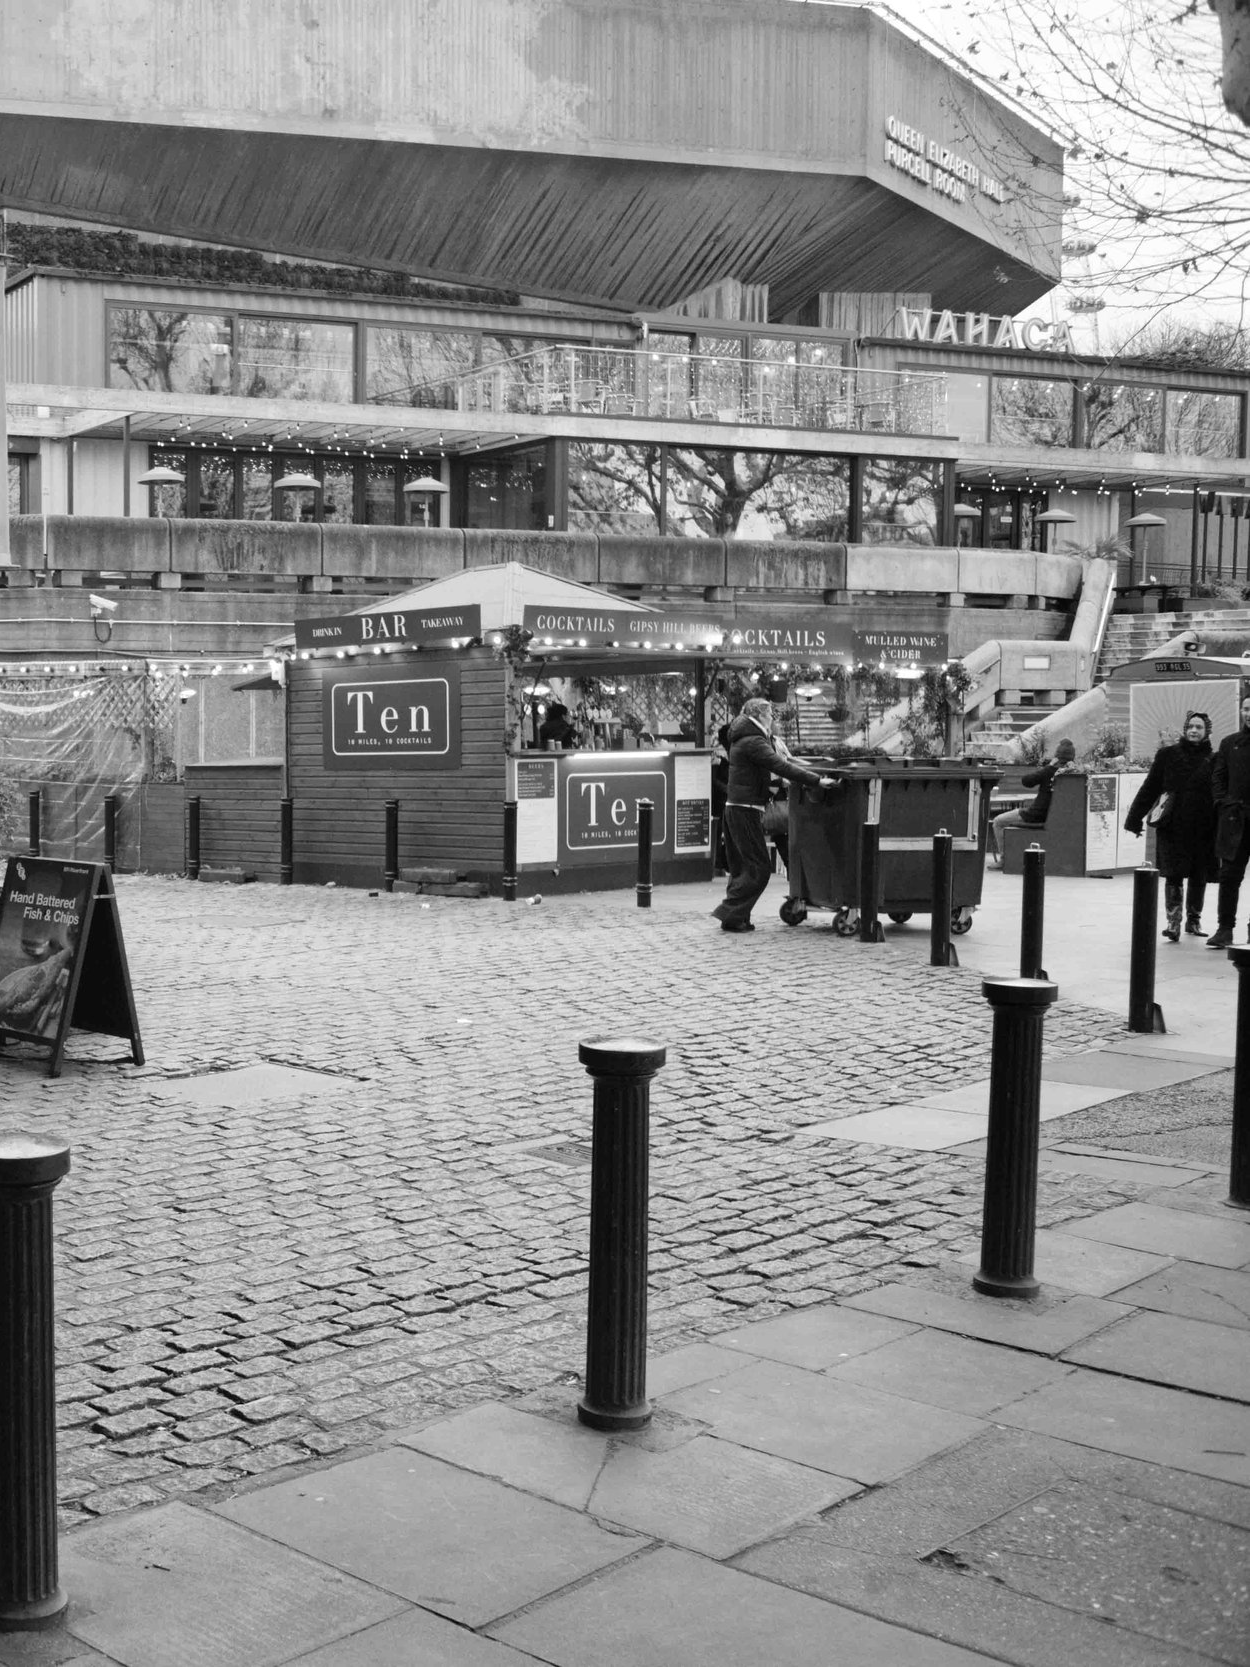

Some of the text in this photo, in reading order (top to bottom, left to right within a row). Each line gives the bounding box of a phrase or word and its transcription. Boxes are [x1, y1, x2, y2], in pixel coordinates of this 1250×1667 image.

[884, 115, 1004, 203] QUEEN ELIZABETH HALL
[884, 140, 966, 203] PURCELL ROOM
[900, 306, 1076, 355] WAHACA
[361, 614, 407, 640] BAR
[421, 616, 464, 629] TAKEAWAY
[537, 614, 615, 633] COCKTAILS
[630, 620, 659, 633] GIPSY
[662, 622, 685, 634] HILL
[729, 628, 827, 648] OCKTAILS
[865, 635, 937, 647] MULLED WINE
[890, 649, 921, 659] CIDER
[347, 691, 432, 734] Ten
[10, 890, 76, 909] Hand Battered
[23, 906, 79, 926] Fish & Chips
